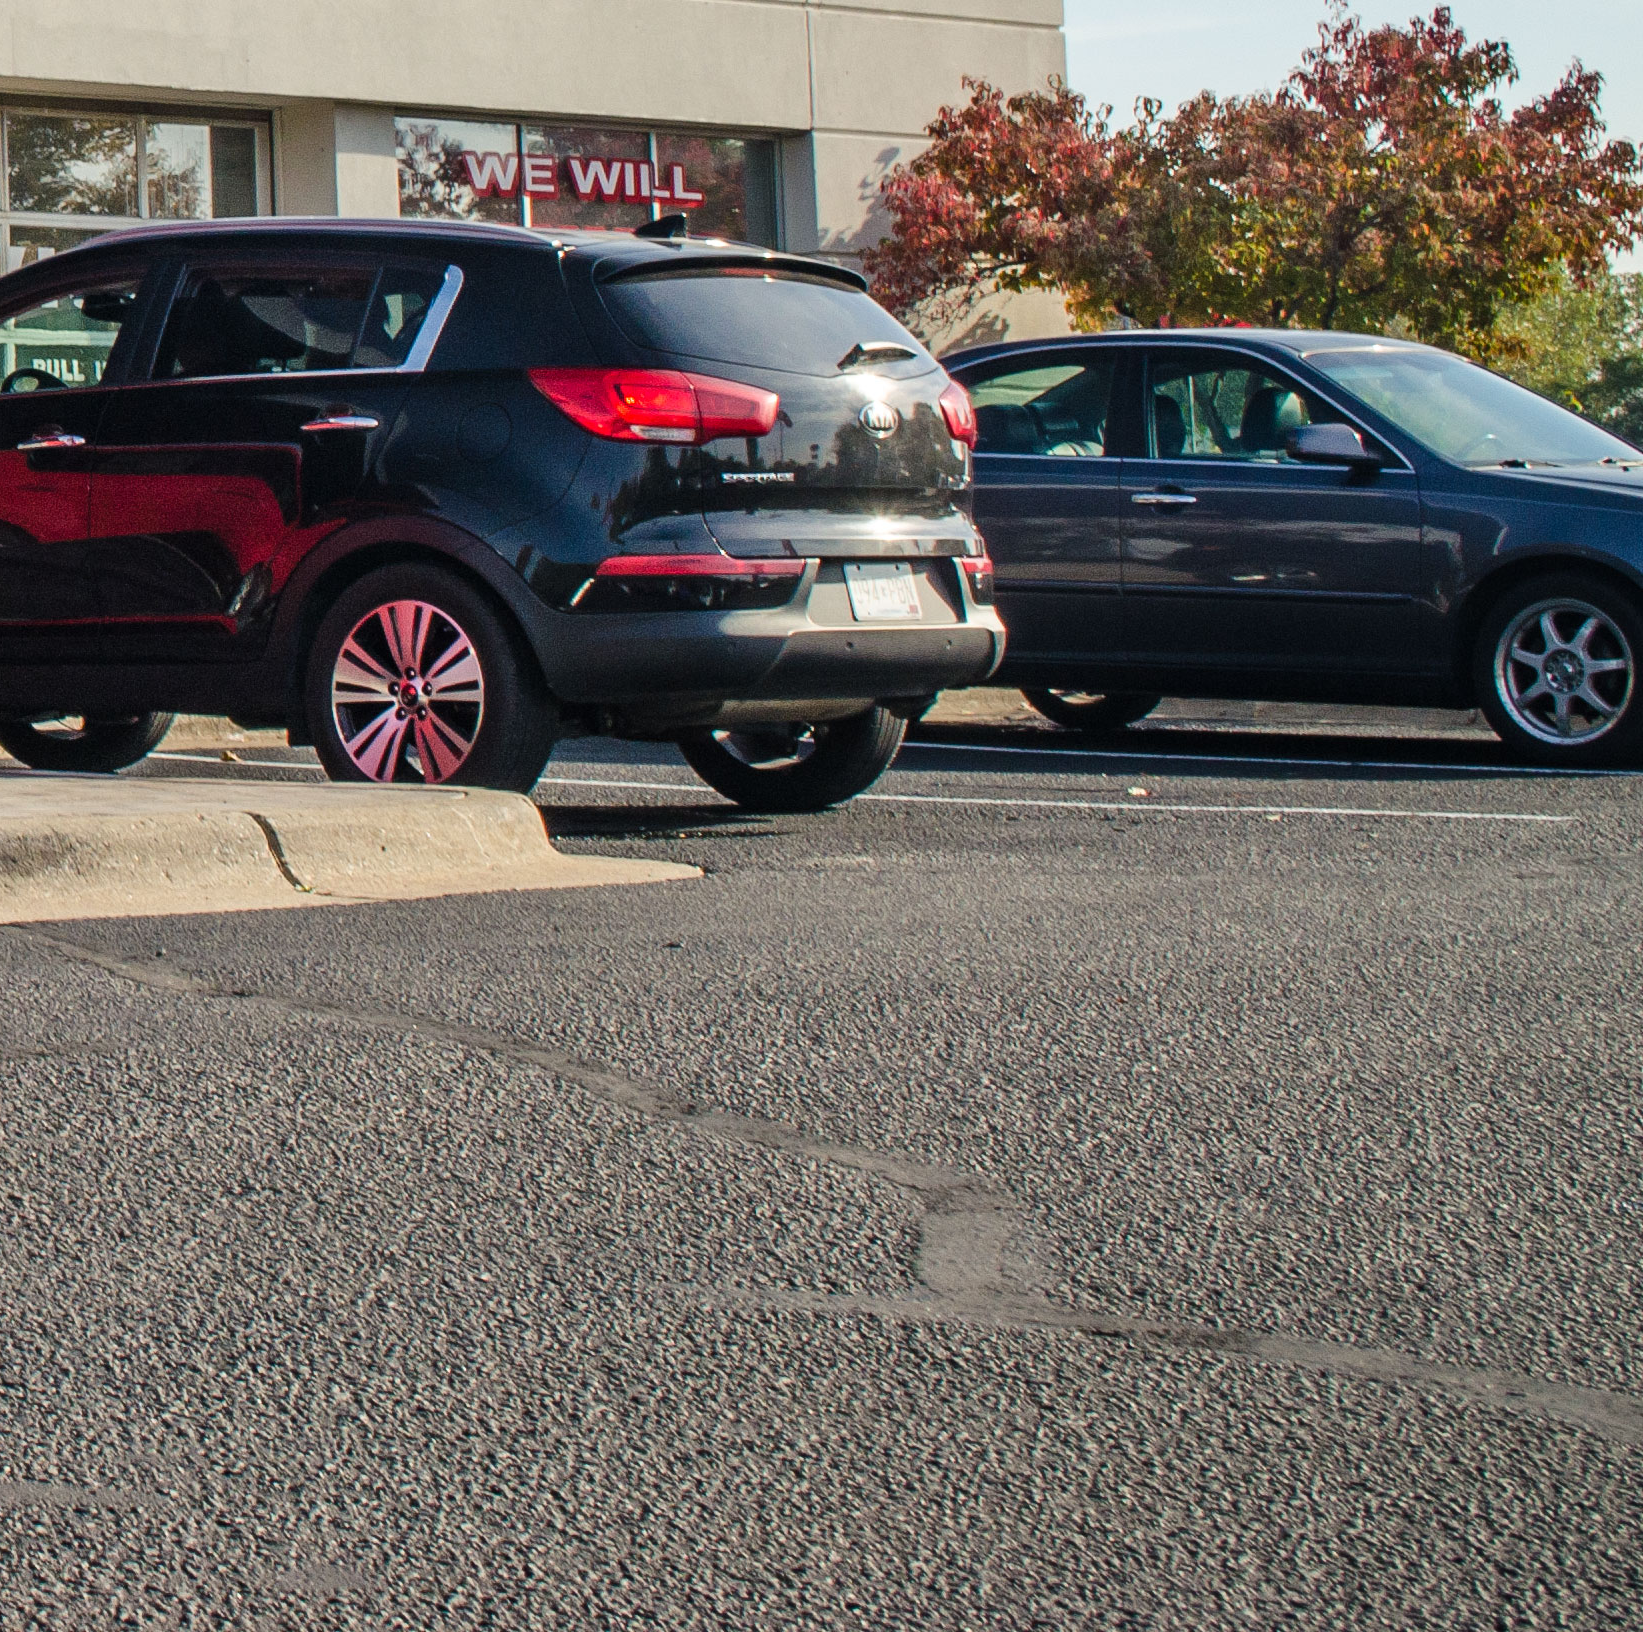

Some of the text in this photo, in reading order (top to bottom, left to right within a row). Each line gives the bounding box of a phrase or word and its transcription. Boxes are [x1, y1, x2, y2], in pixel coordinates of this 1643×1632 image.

[464, 154, 704, 202] WE WILL
[32, 358, 85, 382] PULL
